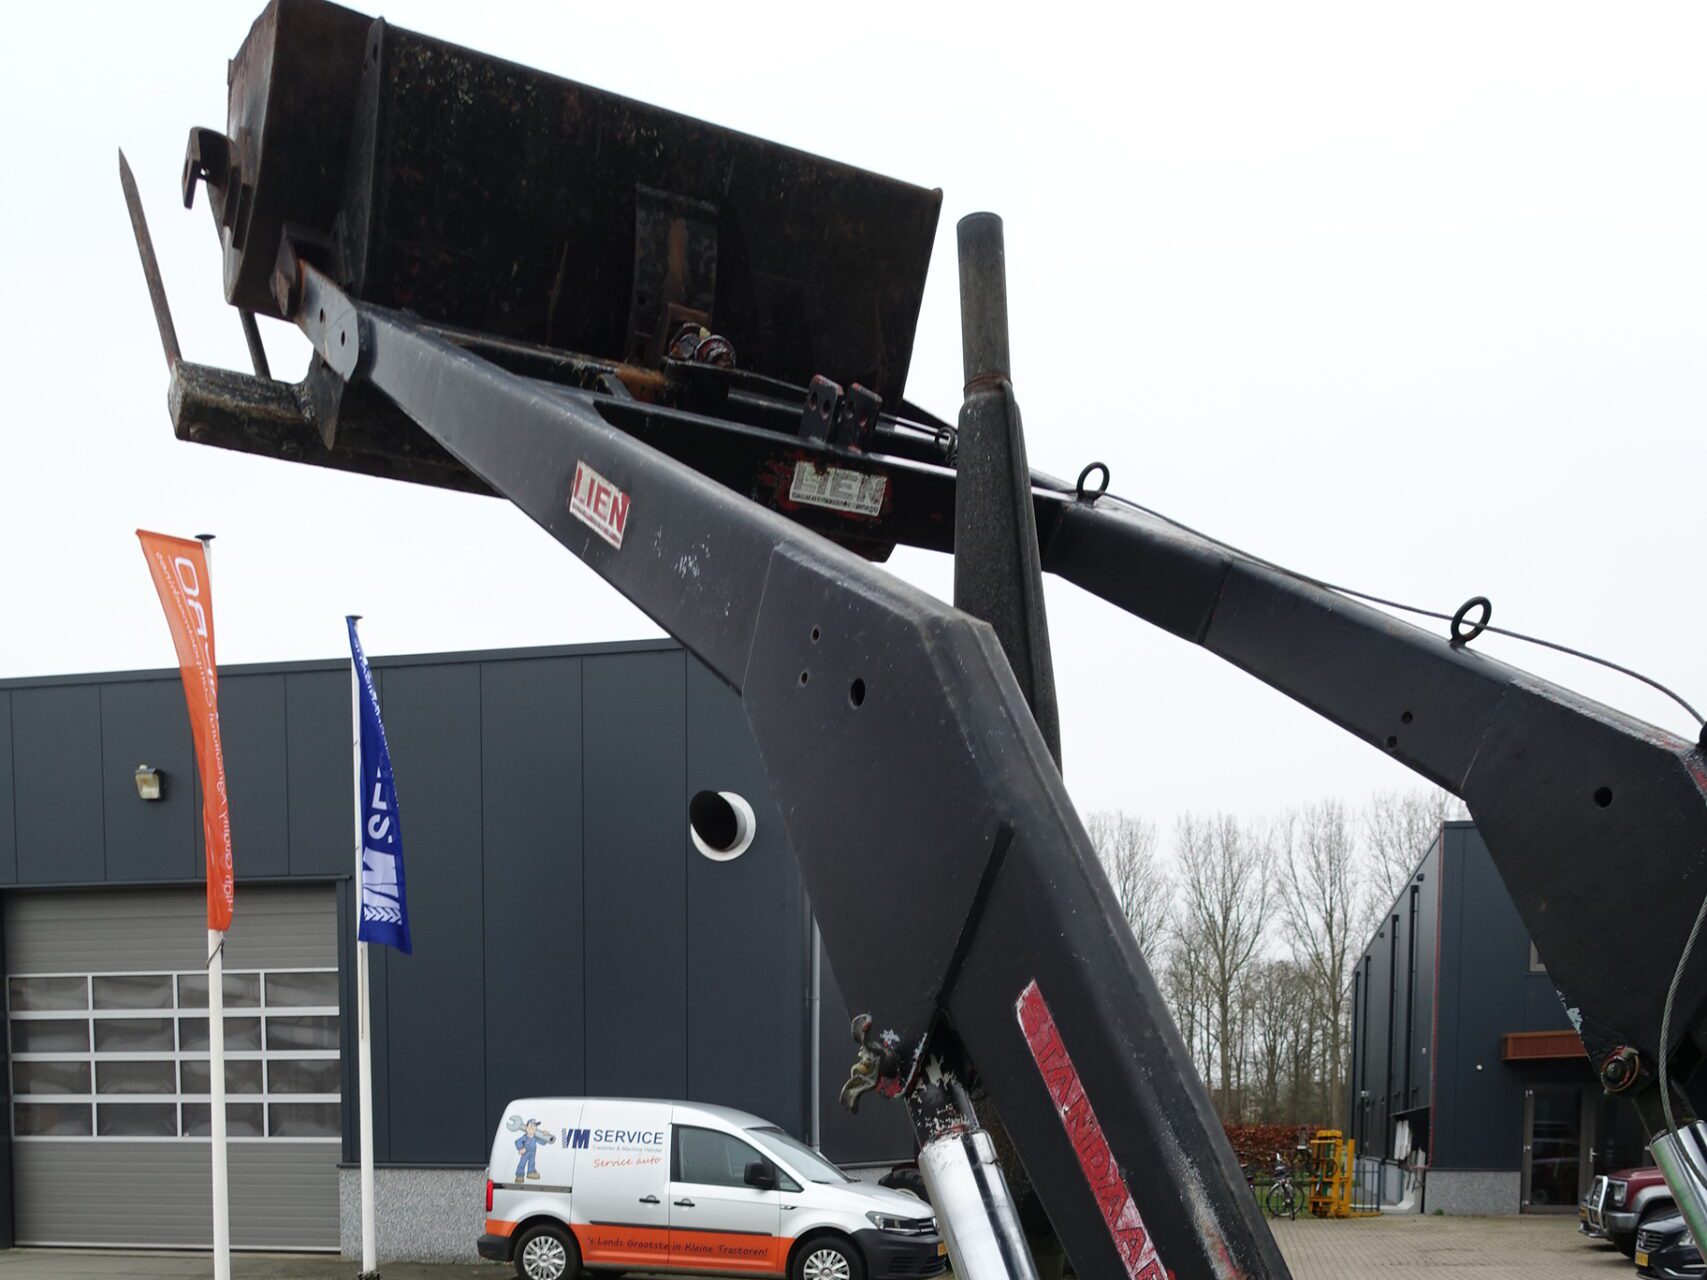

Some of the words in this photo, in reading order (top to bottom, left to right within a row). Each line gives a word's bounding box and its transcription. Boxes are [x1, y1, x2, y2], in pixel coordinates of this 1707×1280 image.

[593, 1129, 664, 1145] SERVICE
[593, 1157, 633, 1168] Service
[636, 1156, 663, 1165] auto
[597, 1237, 623, 1247] Lands
[627, 1239, 669, 1250] Grootste
[672, 1242, 681, 1251] in
[684, 1243, 713, 1254] Kleine
[718, 1244, 768, 1256] Tractoren!
